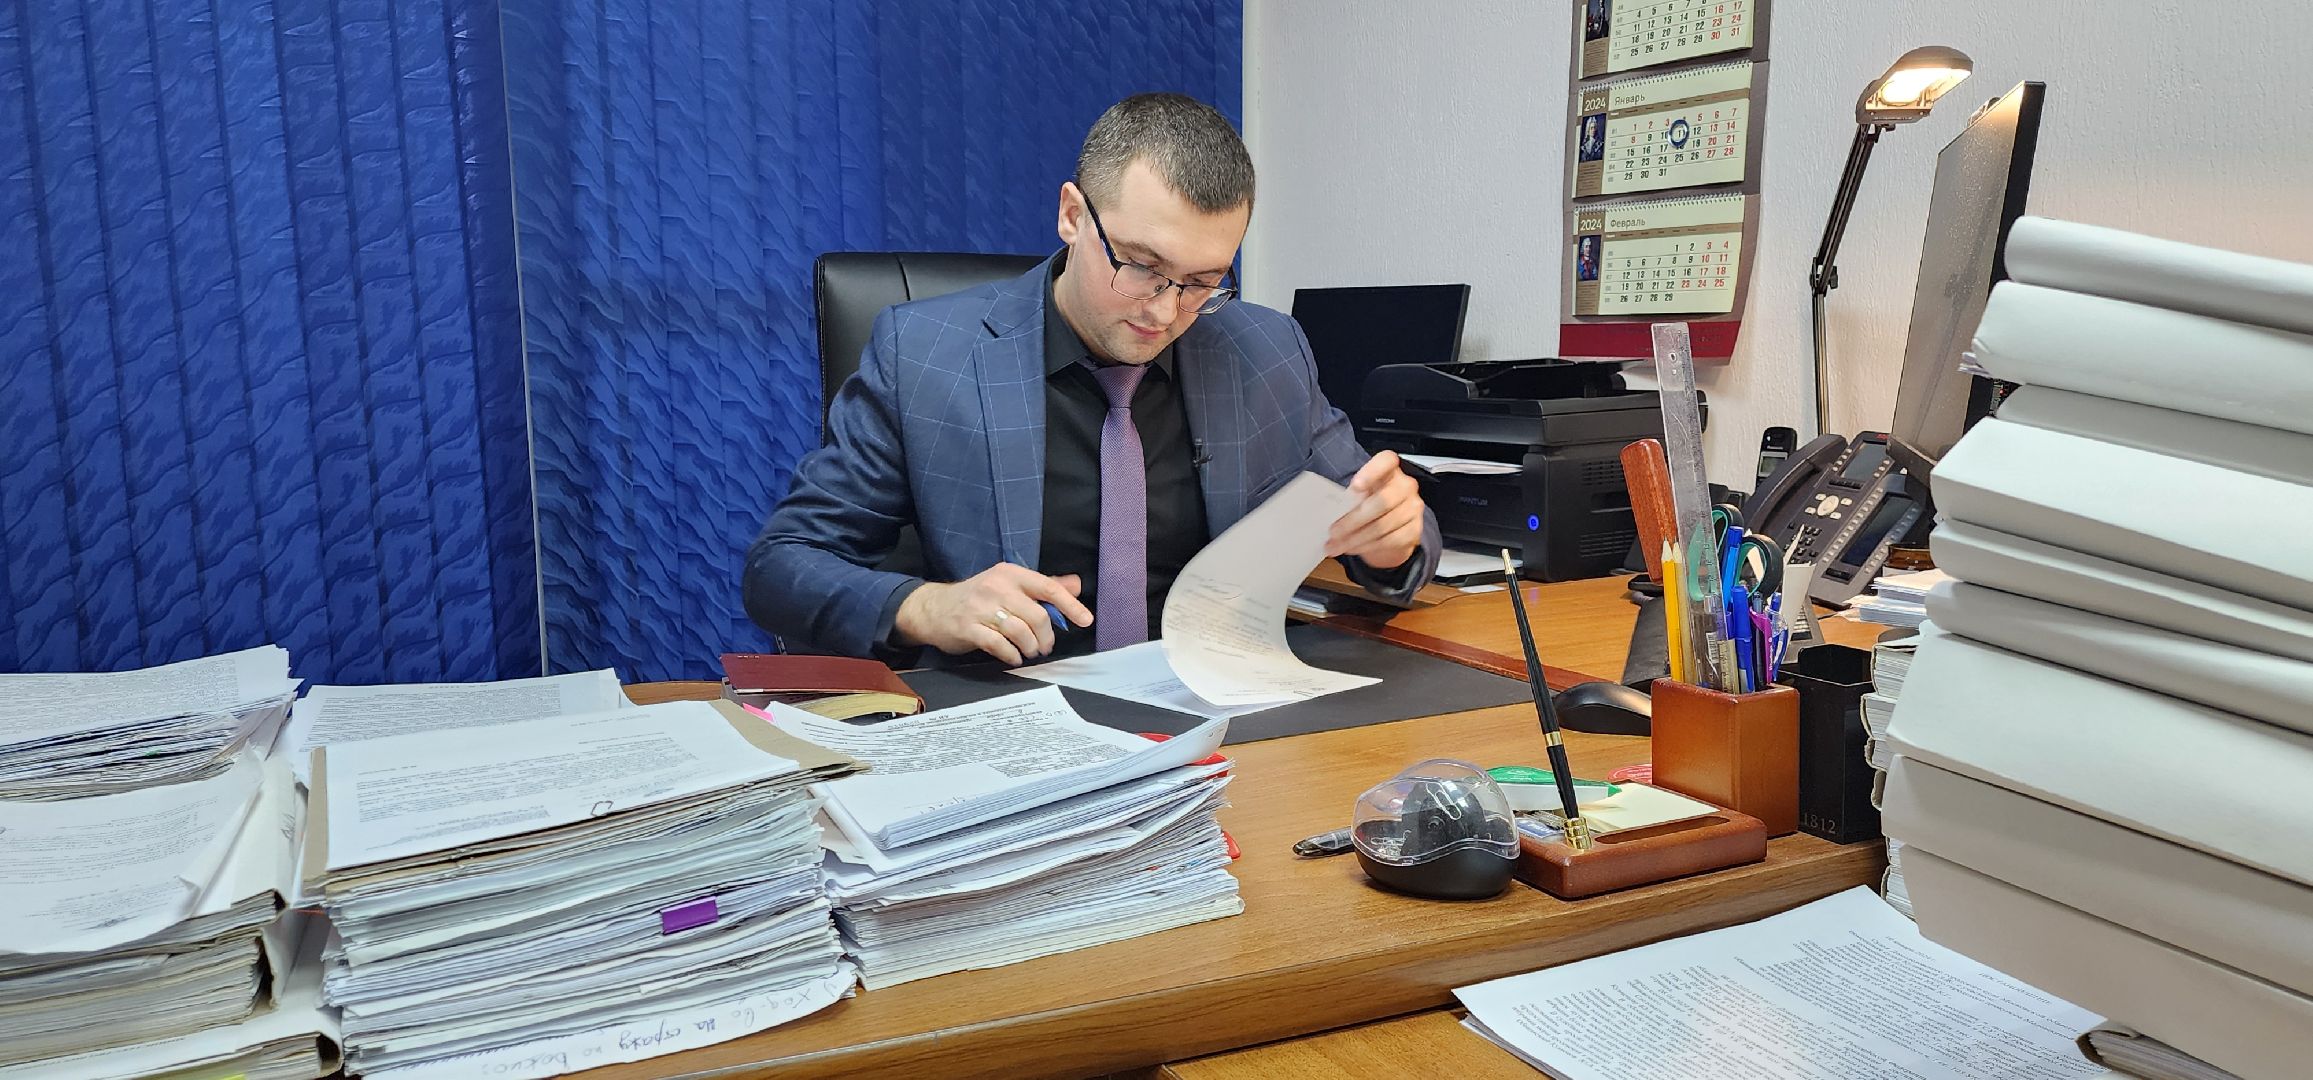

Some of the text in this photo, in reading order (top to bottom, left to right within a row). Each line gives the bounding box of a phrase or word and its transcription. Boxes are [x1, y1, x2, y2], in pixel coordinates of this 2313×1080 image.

[1634, 24, 1640, 32] 11
[1648, 20, 1655, 29] 12
[1663, 16, 1672, 24] 13
[1680, 13, 1688, 21] 14
[1697, 9, 1706, 17] 15
[1714, 5, 1724, 14] 16
[1734, 1, 1742, 10] 17
[1632, 35, 1639, 44] 18
[1647, 32, 1654, 40] 19
[1662, 28, 1671, 37] 20
[1679, 25, 1688, 34] 21
[1695, 21, 1705, 30] 22
[1712, 18, 1722, 27] 23
[1731, 14, 1741, 23] 24
[1630, 48, 1639, 57] 25
[1645, 45, 1654, 54] 26
[1660, 41, 1669, 50] 27
[1677, 38, 1686, 47] 28
[1693, 35, 1703, 44] 29
[1711, 31, 1720, 40] 30
[1731, 27, 1740, 36] 31
[1584, 94, 1645, 112] 2024 Январь
[1648, 121, 1653, 129] 2
[1698, 113, 1703, 122] 5
[1714, 111, 1720, 119] 6
[1732, 107, 1737, 117] 7
[1631, 136, 1636, 144] 8
[1647, 134, 1652, 142] 9
[1693, 127, 1701, 135] 12
[1710, 123, 1718, 132] 13
[1727, 121, 1736, 131] 14
[1627, 149, 1635, 157] 15
[1642, 146, 1651, 155] 16
[1660, 144, 1668, 152] 17
[1692, 139, 1701, 147] 19
[1708, 137, 1717, 146] 20
[1726, 134, 1735, 143] 21
[1625, 160, 1634, 168] 22
[1641, 157, 1650, 166] 23
[1658, 156, 1667, 164] 24
[1674, 154, 1684, 162] 25
[1690, 152, 1699, 160] 26
[1706, 149, 1716, 158] 27
[1724, 147, 1734, 157] 28
[1624, 168, 1667, 180] 29 30 31
[1580, 219, 1601, 231] 2024
[1610, 218, 1646, 230] Февраль
[1689, 243, 1695, 251] 2
[1707, 241, 1712, 249] 3
[1723, 240, 1729, 249] 4
[1626, 253, 1728, 267] 5 6 7 8 9 10 11
[1622, 272, 1630, 280] 12
[1637, 270, 1645, 279] 13
[1652, 270, 1661, 278] 14
[1667, 268, 1676, 277] 15
[1683, 267, 1692, 276] 16
[1700, 267, 1708, 276] 17
[1716, 266, 1726, 275] 18
[1622, 282, 1629, 291] 19
[1636, 282, 1644, 290] 20
[1652, 281, 1659, 290] 21
[1666, 280, 1675, 289] 22
[1681, 279, 1690, 288] 23
[1698, 279, 1707, 288] 24
[1714, 278, 1725, 287] 25
[1620, 295, 1628, 303] 26
[1635, 294, 1643, 302] 27
[1650, 293, 1659, 302] 28
[1664, 293, 1674, 301] 29
[1802, 812, 1837, 835] 1812
